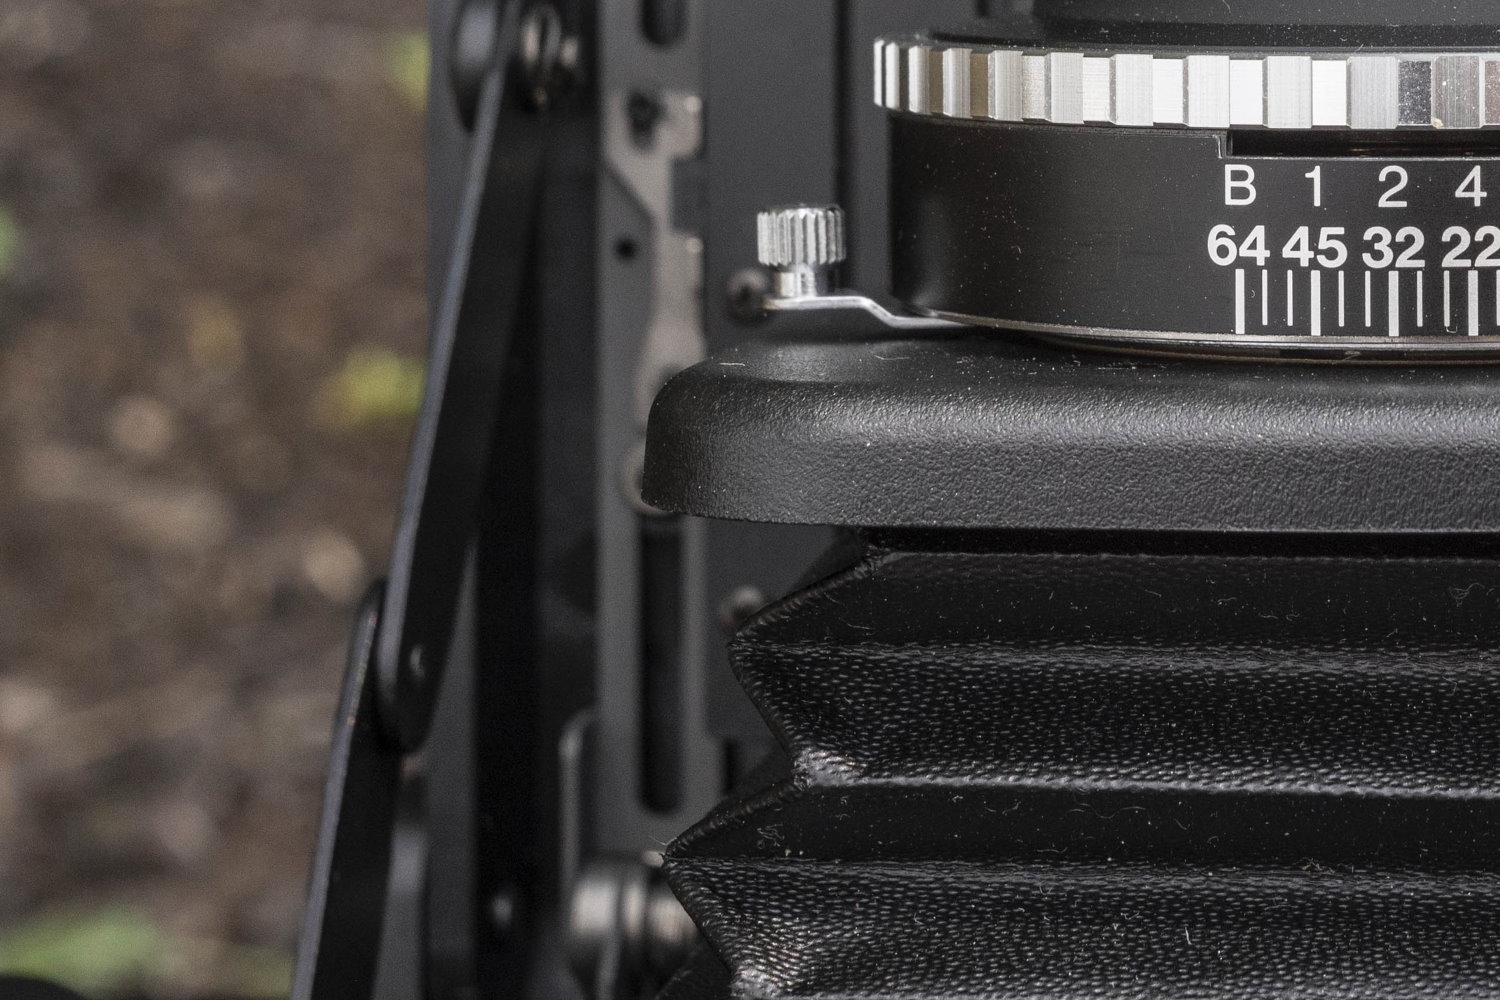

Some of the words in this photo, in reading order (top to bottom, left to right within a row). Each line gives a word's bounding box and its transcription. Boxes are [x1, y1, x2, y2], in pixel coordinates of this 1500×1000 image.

[1225, 163, 1257, 207] B
[1304, 164, 1322, 208] 1
[1377, 164, 1409, 208] 2
[1454, 164, 1488, 208] 4
[1206, 223, 1271, 267] 64
[1281, 225, 1348, 269] 45
[1361, 225, 1426, 269] 32
